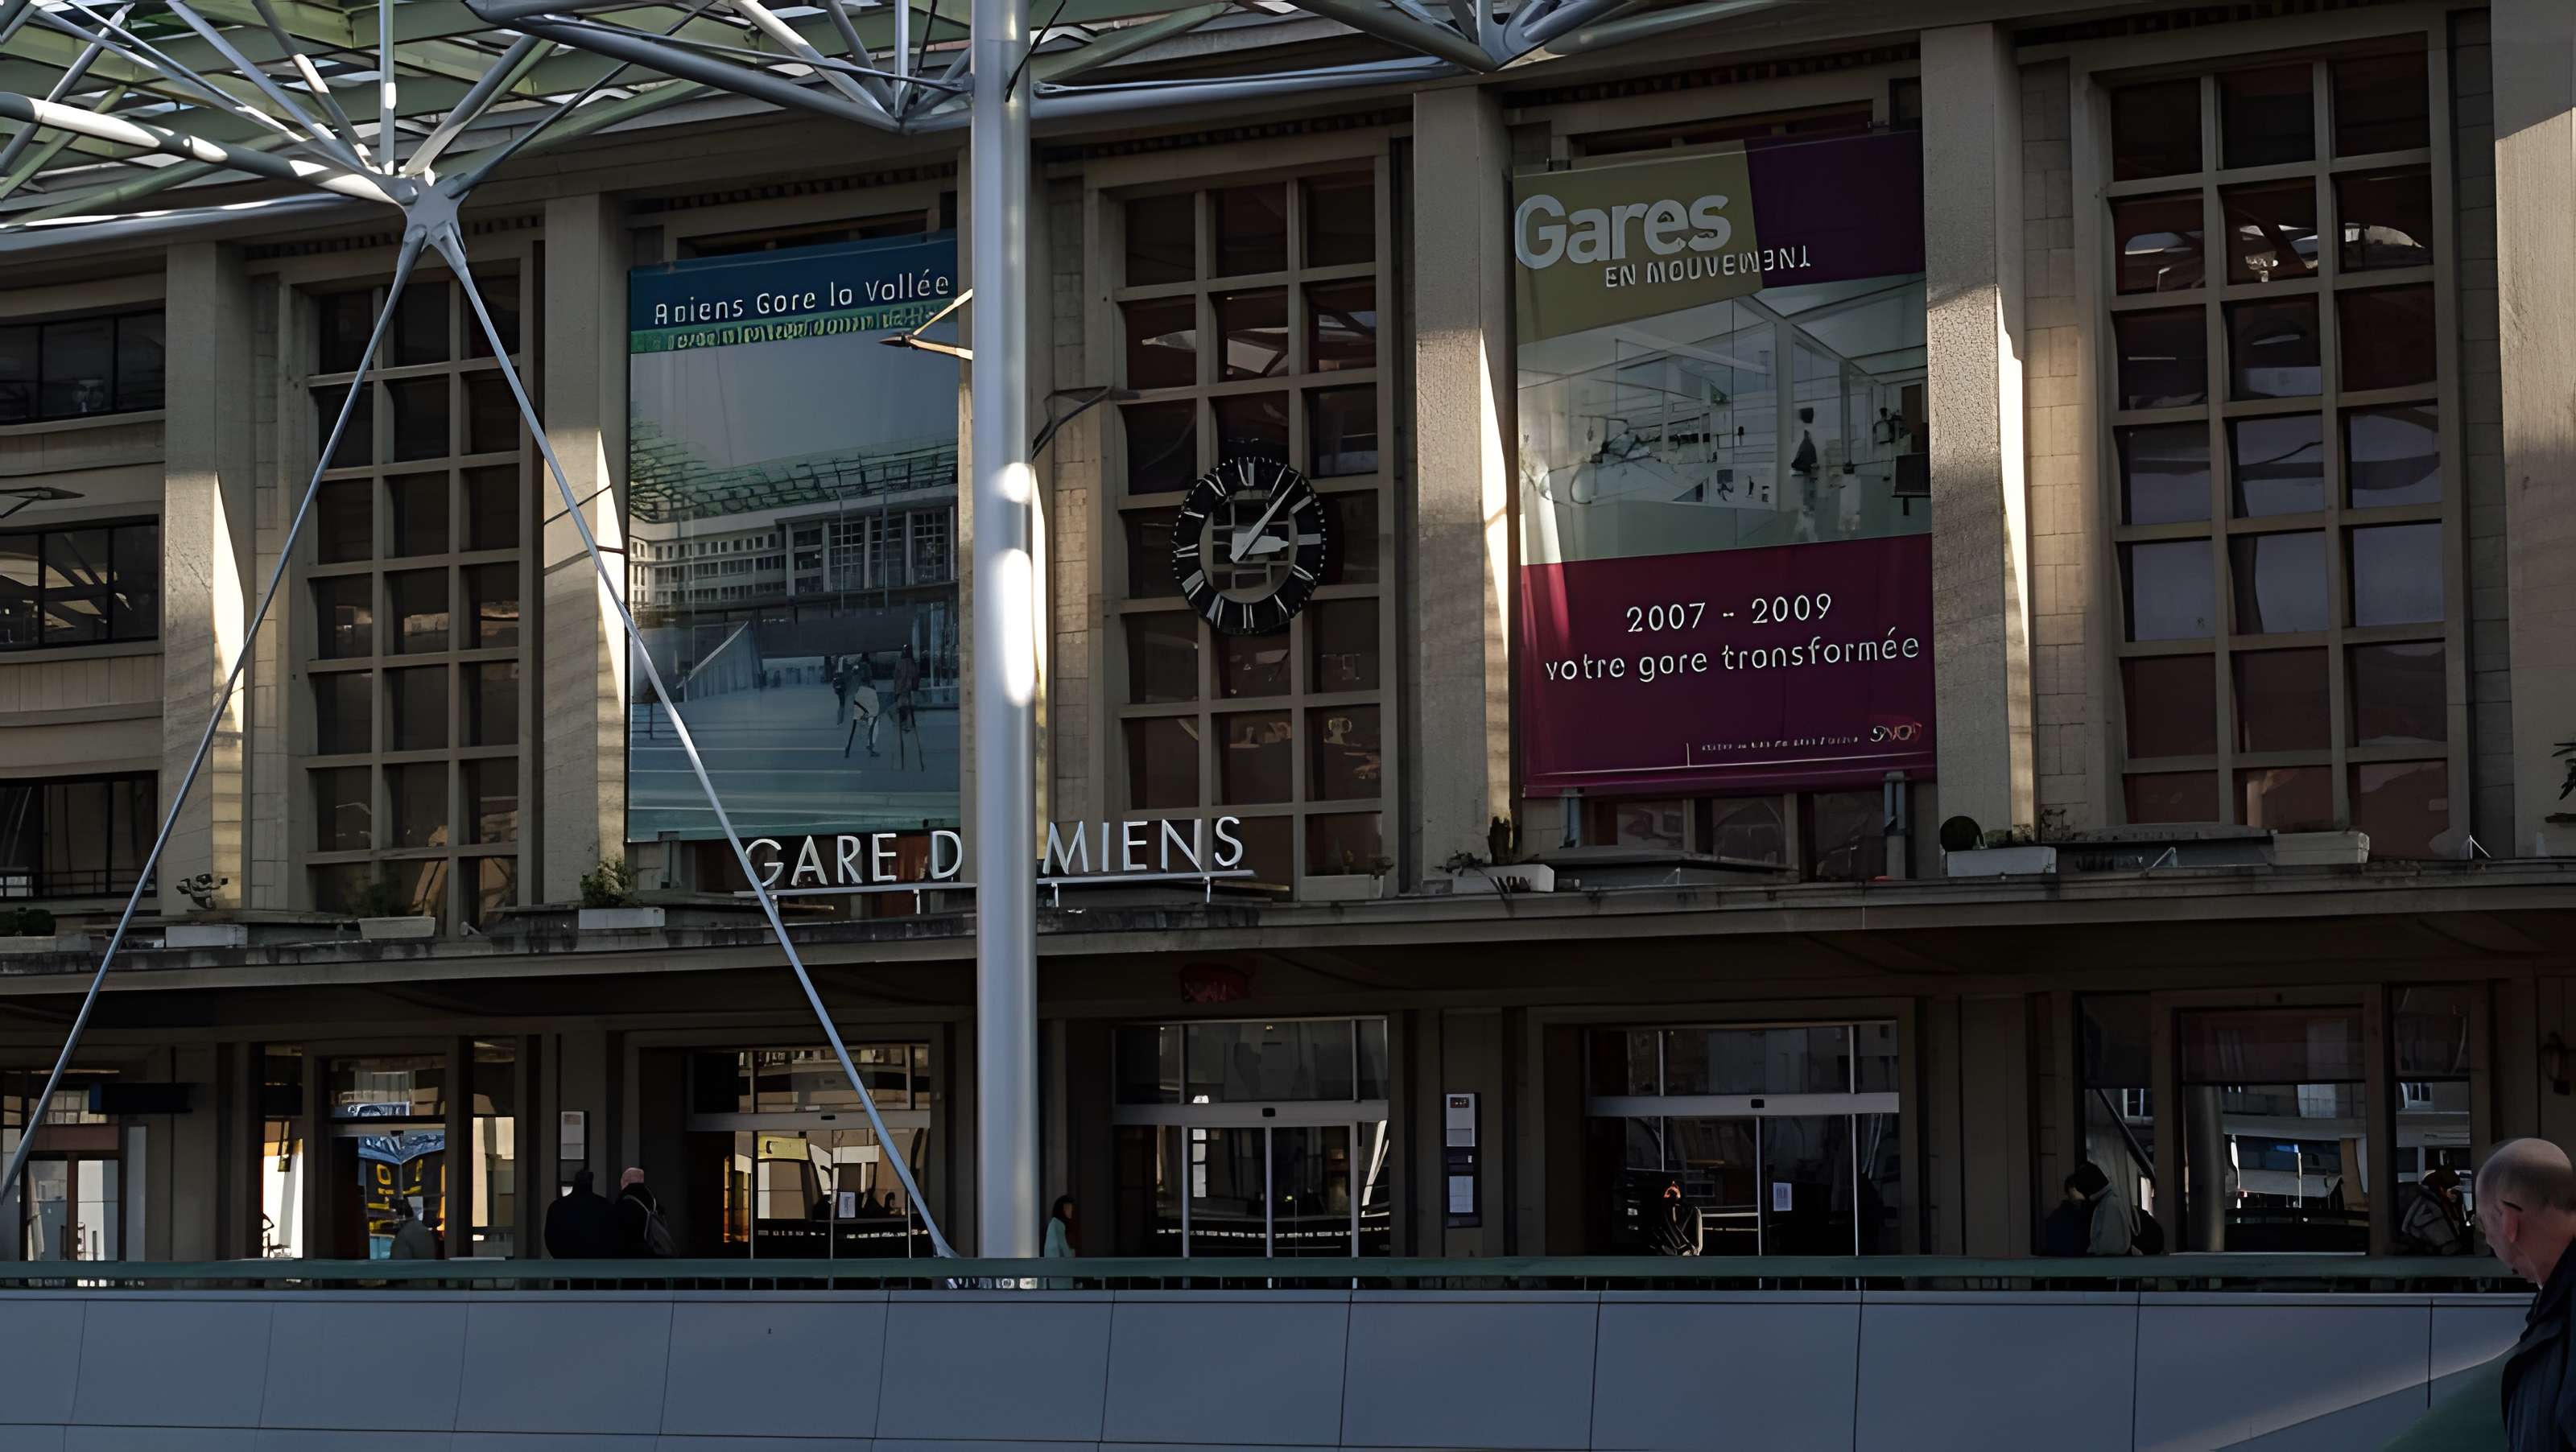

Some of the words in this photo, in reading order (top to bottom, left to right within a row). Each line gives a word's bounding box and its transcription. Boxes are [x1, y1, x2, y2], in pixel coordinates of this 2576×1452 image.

[1513, 193, 1732, 270] Gares
[1604, 262, 1636, 288] EN
[1625, 601, 1707, 633] 2007
[1751, 592, 1832, 625] 2009
[744, 831, 898, 888] GARE
